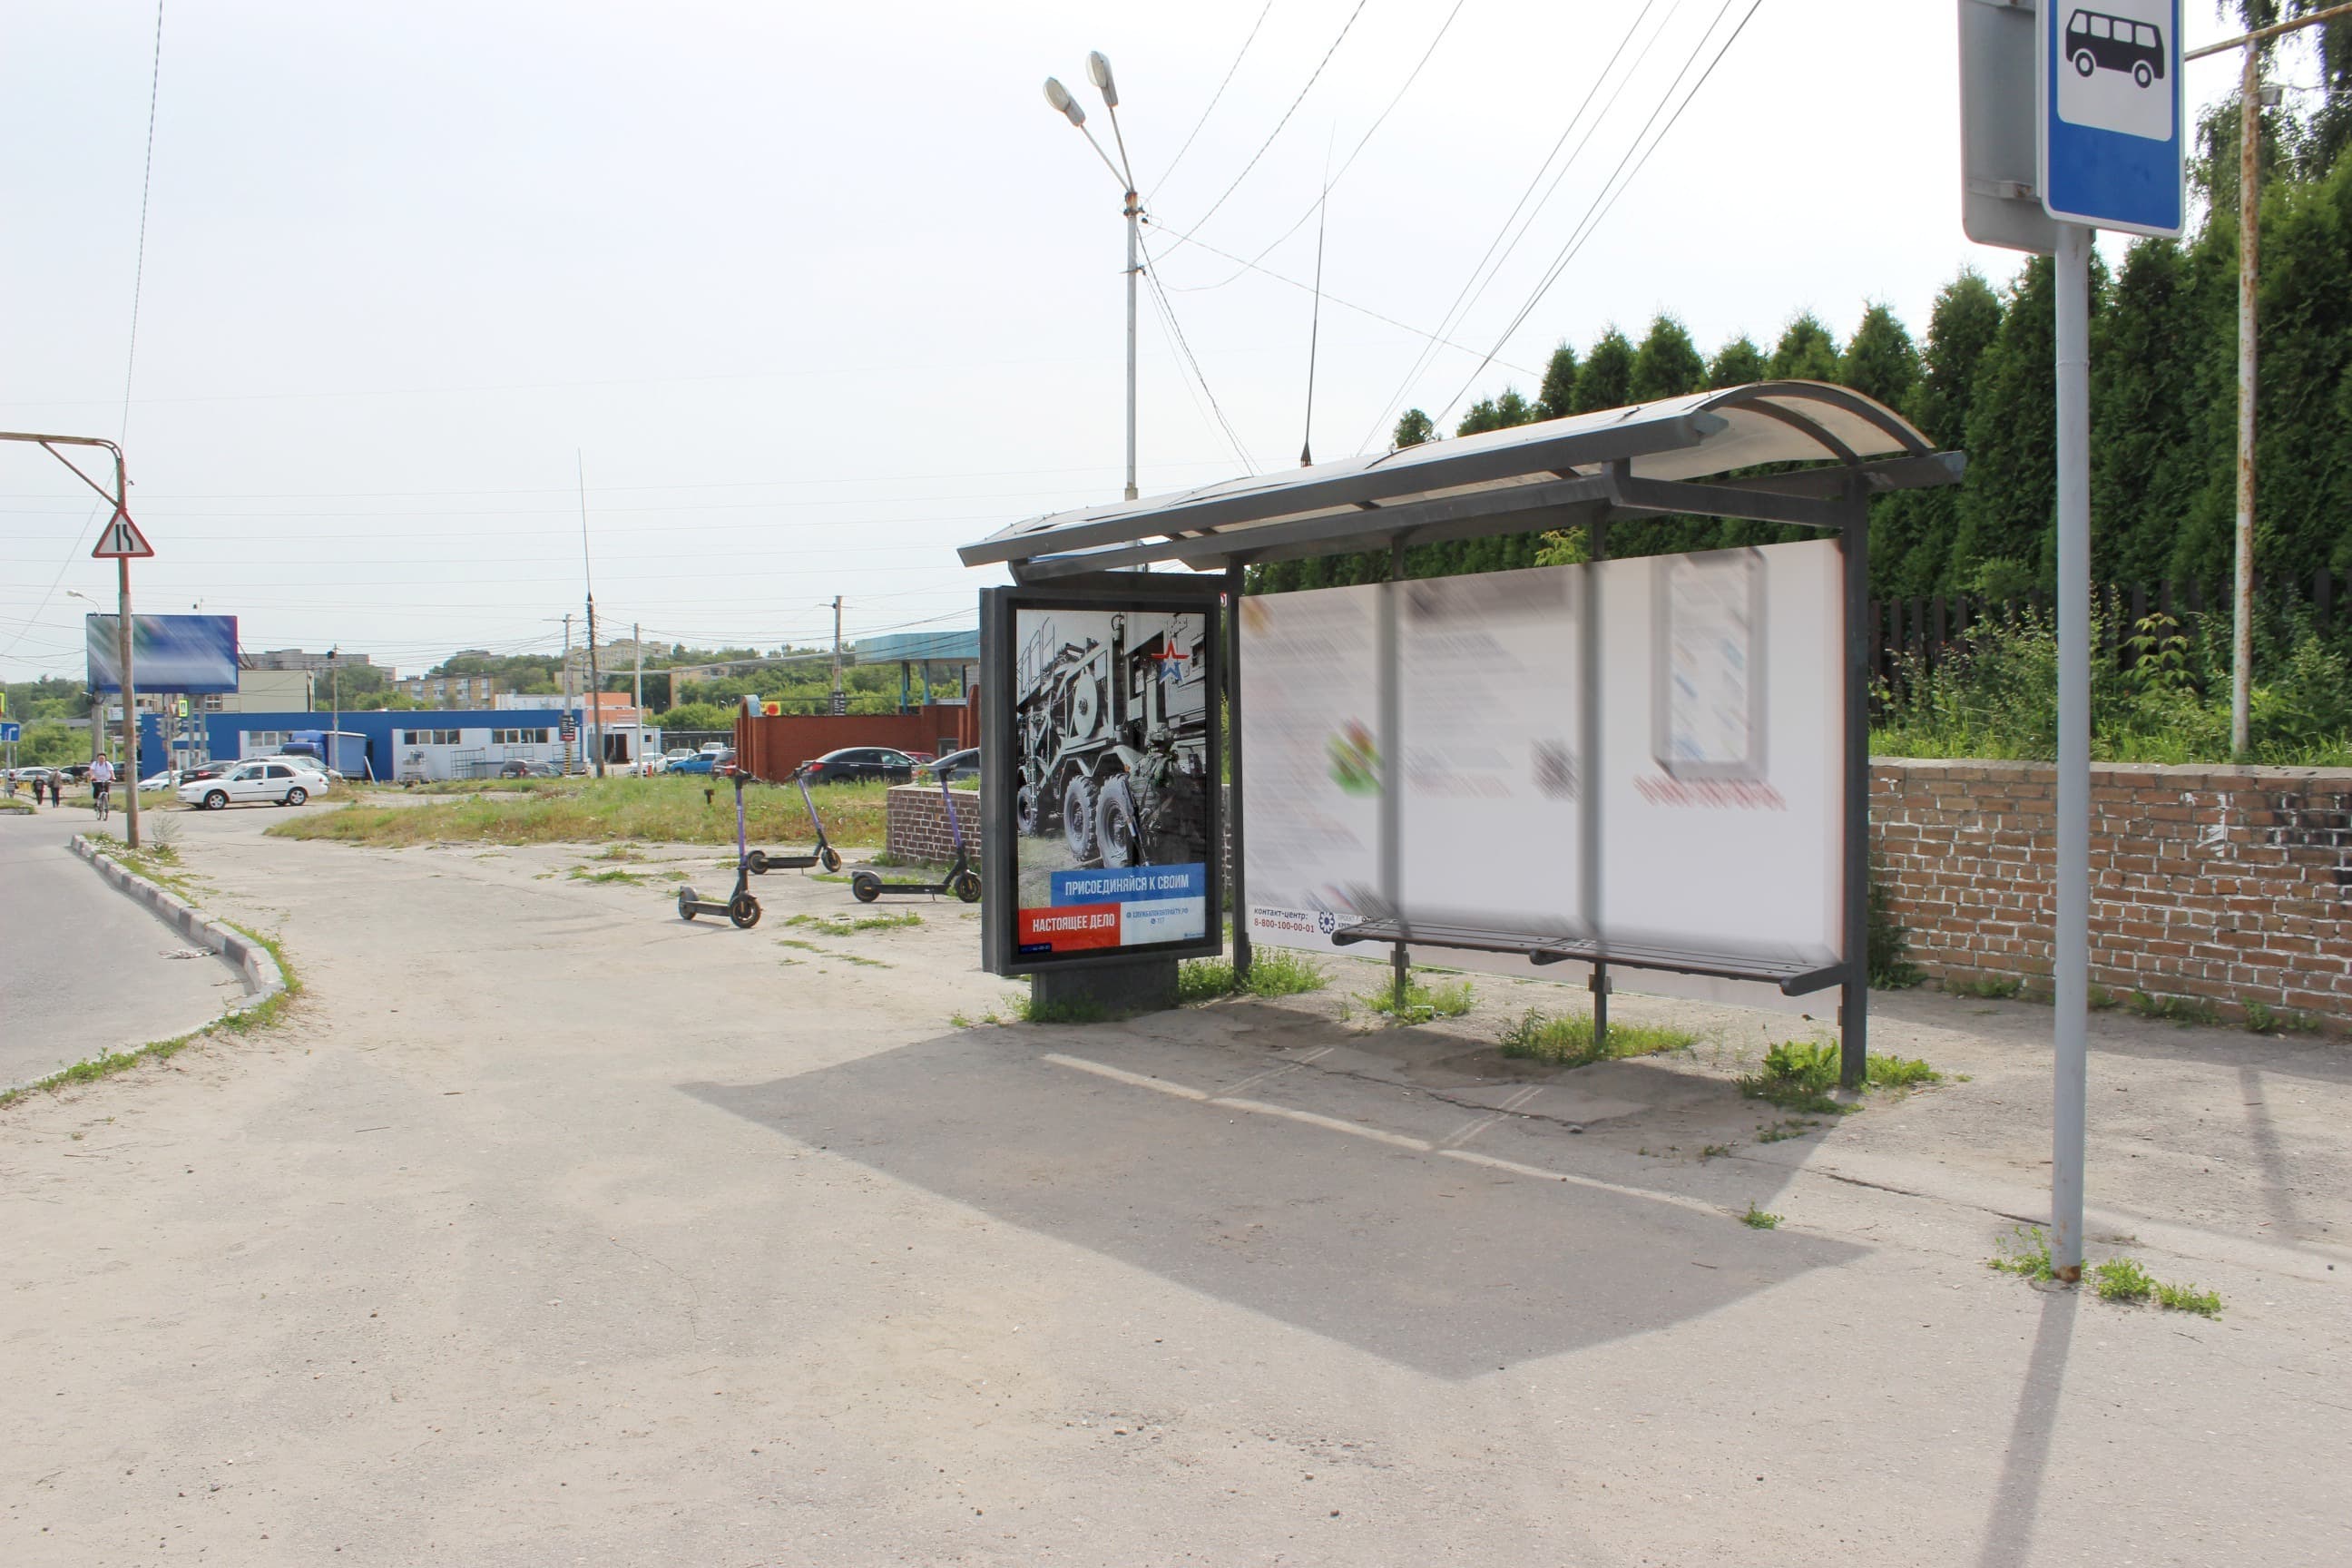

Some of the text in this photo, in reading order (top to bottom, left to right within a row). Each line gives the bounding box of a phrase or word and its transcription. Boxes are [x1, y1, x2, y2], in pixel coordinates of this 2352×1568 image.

[1065, 874, 1189, 896] ПРИСОЕДИНЯЙСЯ К СВОИМ
[1033, 913, 1115, 933] НАСТОЯЩЕЕ ДЕЛО
[1254, 907, 1308, 921] контакт-центр:
[1254, 917, 1315, 933] 8-800-100-00-01
